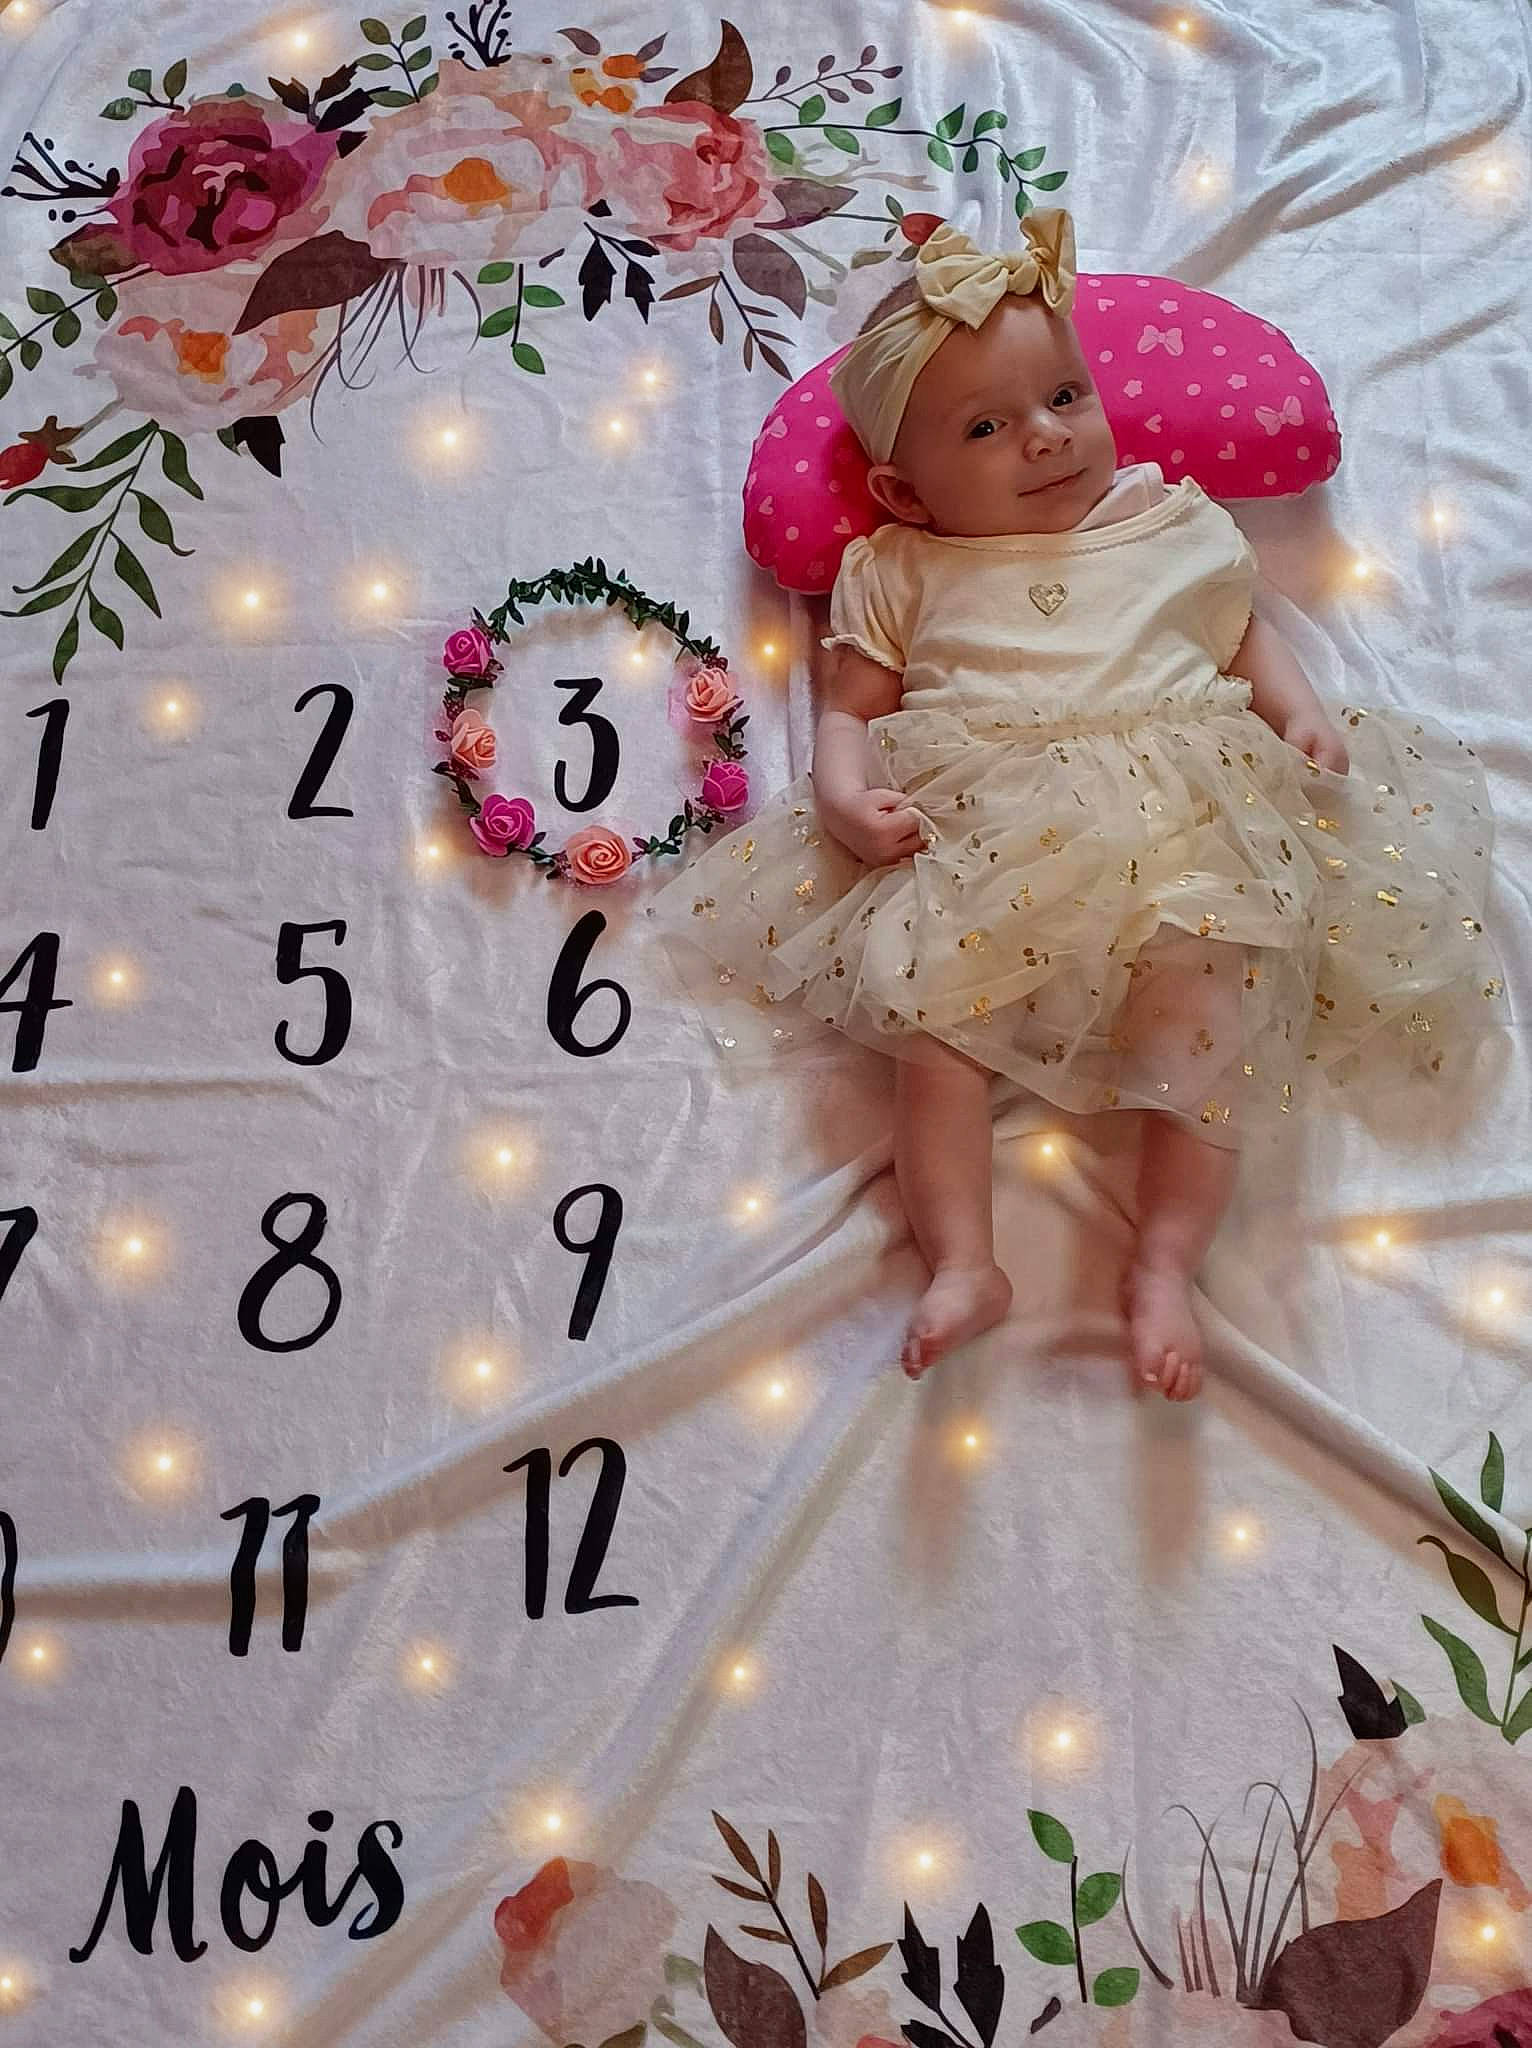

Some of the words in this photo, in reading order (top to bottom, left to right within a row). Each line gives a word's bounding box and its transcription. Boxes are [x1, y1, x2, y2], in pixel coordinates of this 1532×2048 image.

[25, 698, 70, 831] 1
[287, 683, 354, 820] 2
[553, 677, 620, 813] 3
[0, 931, 74, 1073] 4
[274, 919, 352, 1066] 5
[546, 909, 632, 1058] 6
[237, 1191, 342, 1354] 8
[552, 1183, 623, 1342] 9
[219, 1493, 321, 1657] 11
[502, 1436, 640, 1620] 12
[68, 1785, 405, 1964] Mois
